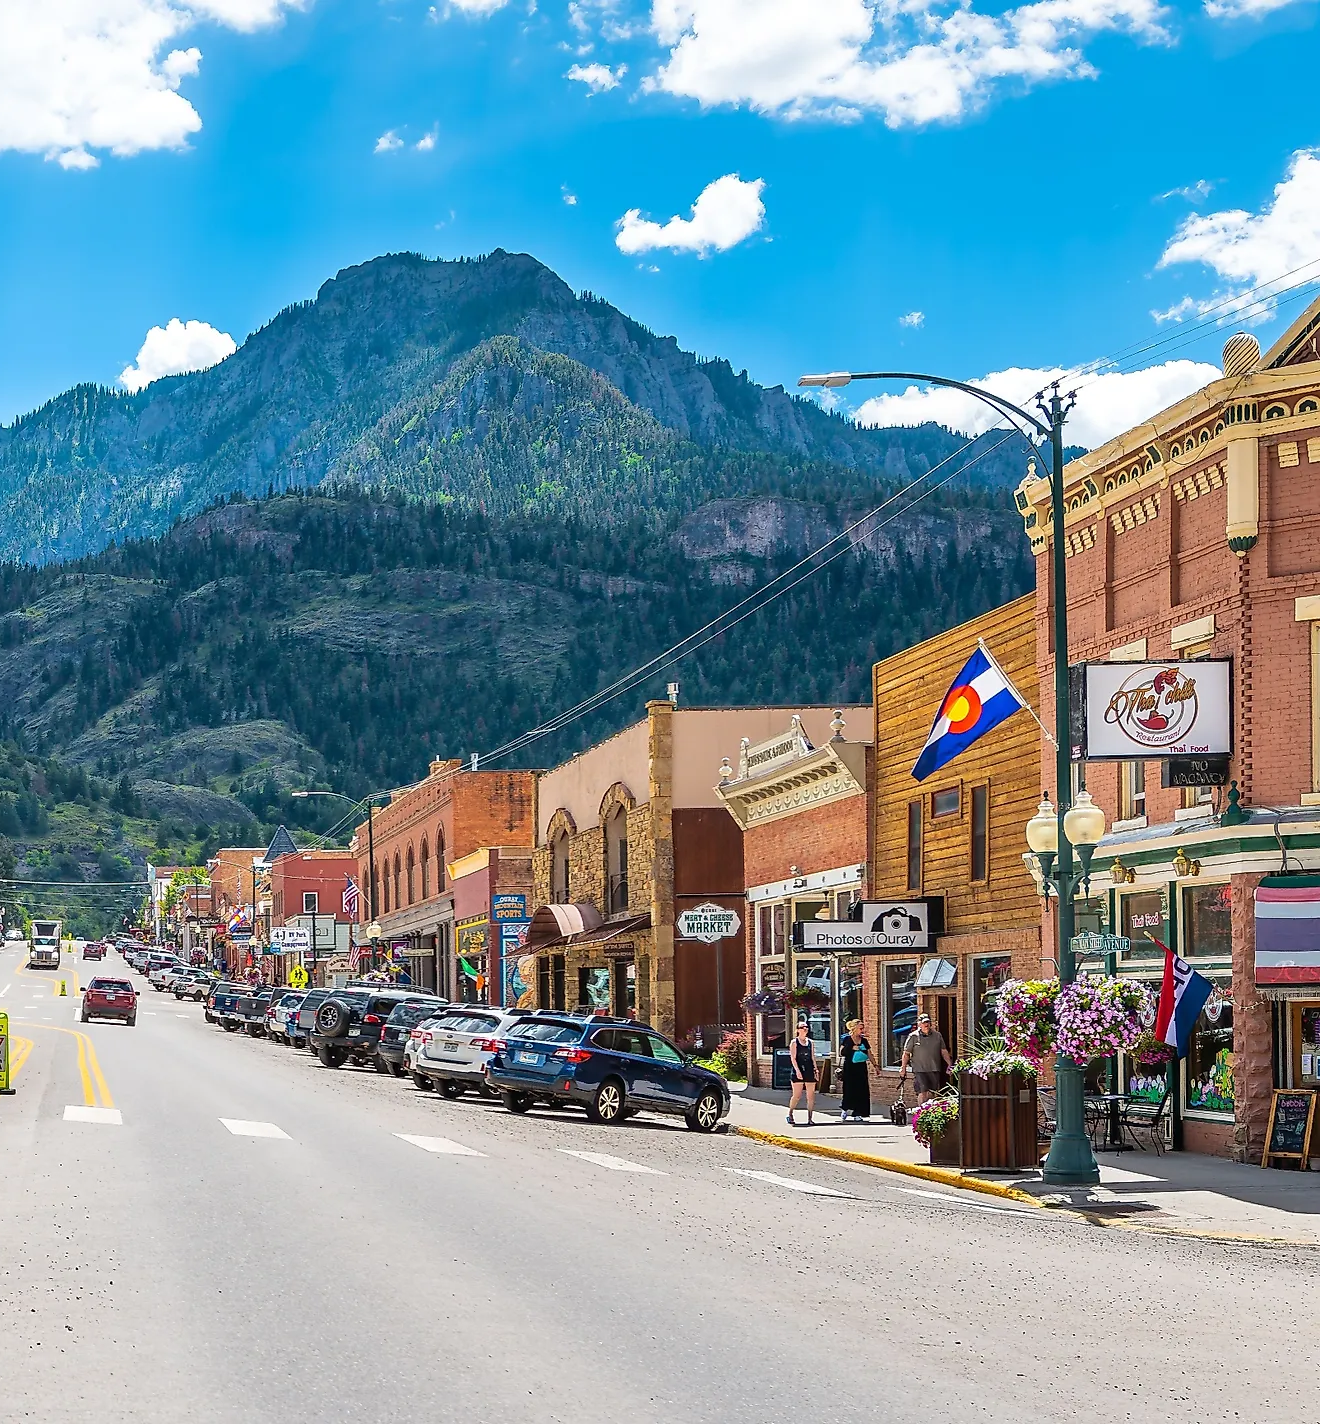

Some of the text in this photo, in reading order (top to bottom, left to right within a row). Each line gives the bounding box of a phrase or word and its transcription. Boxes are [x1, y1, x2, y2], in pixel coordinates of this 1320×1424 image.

[1105, 685, 1161, 724] Thai
[1136, 727, 1181, 742] Restaurant
[1169, 744, 1187, 753] Thai
[496, 910, 522, 918] SPORTS
[1131, 911, 1160, 928] Thai Food
[687, 922, 731, 933] MARKET
[816, 933, 917, 946] Photos of Ouray
[1104, 940, 1129, 951] AVENUE
